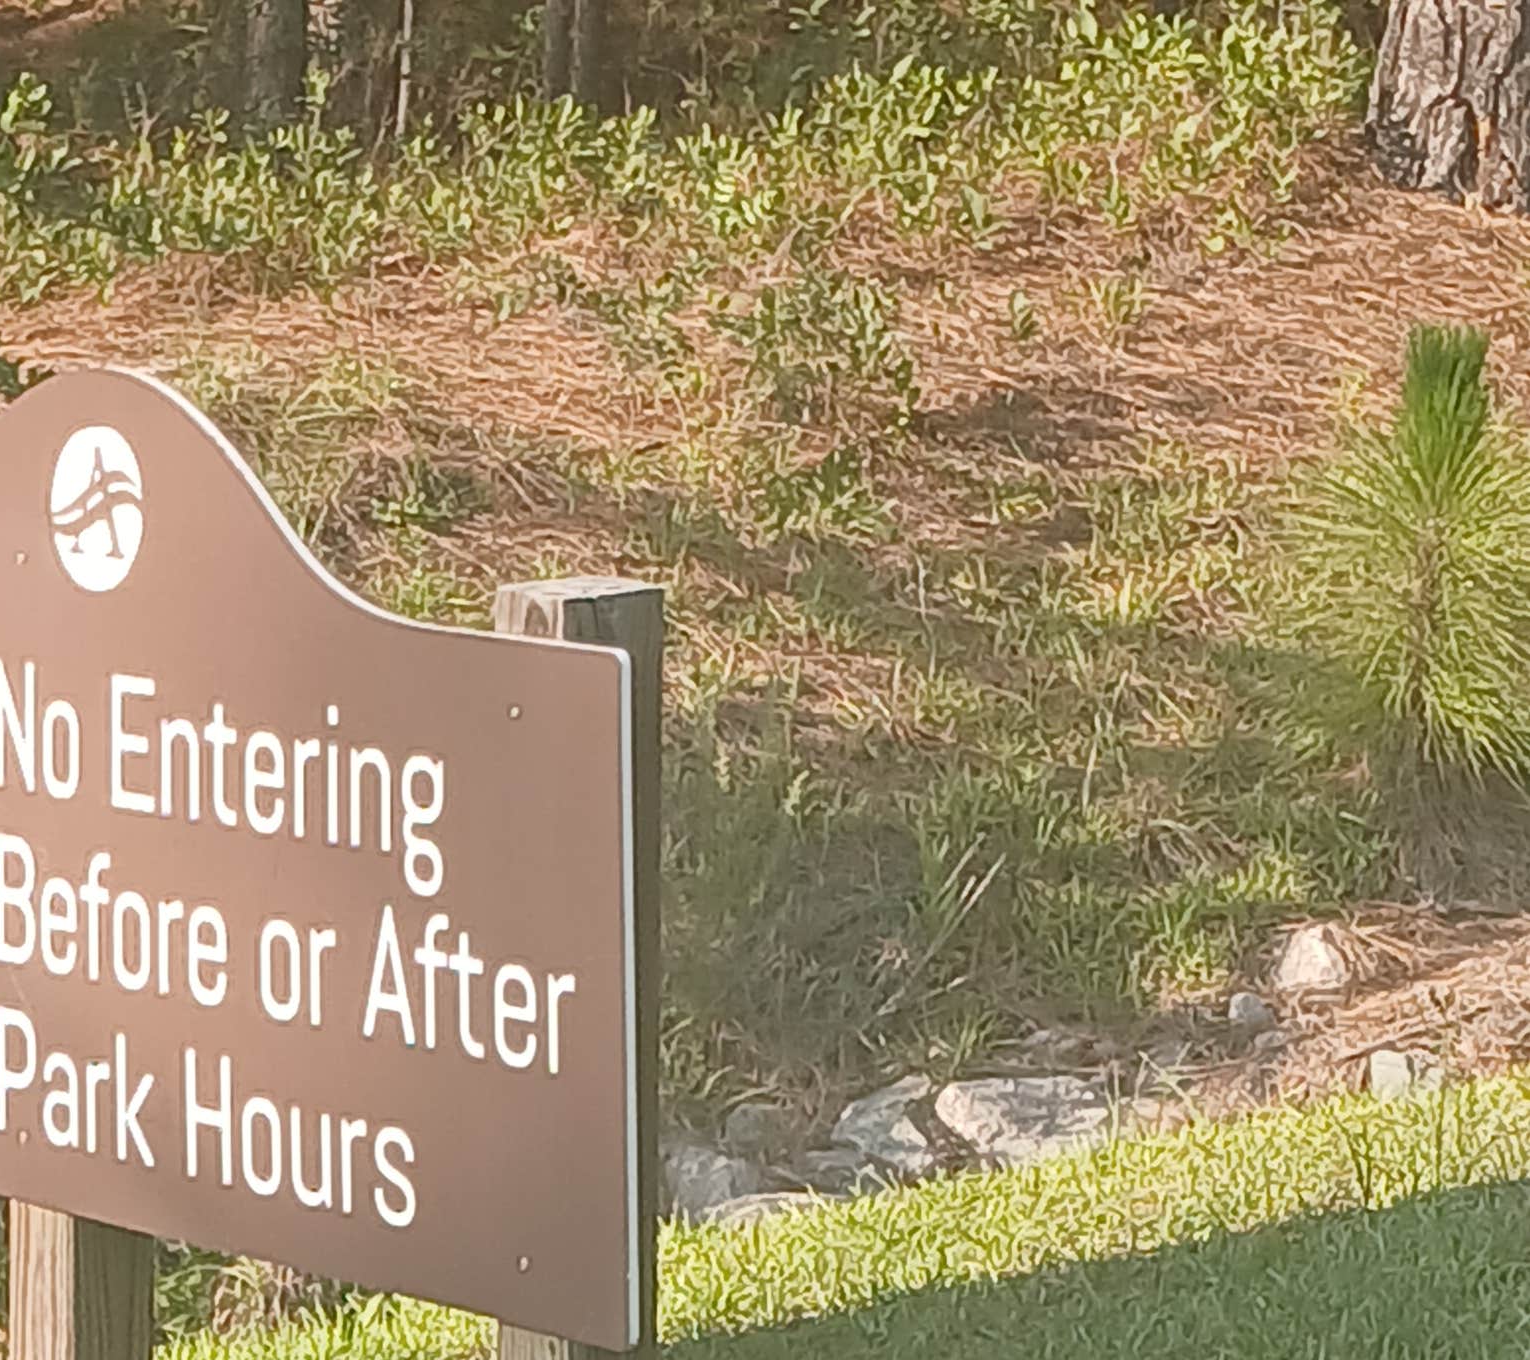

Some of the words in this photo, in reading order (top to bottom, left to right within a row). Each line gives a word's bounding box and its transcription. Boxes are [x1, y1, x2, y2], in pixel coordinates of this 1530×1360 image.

[110, 673, 445, 898] Entering
[259, 918, 338, 1027] or
[362, 904, 577, 1075] After
[183, 1047, 417, 1228] Hours
